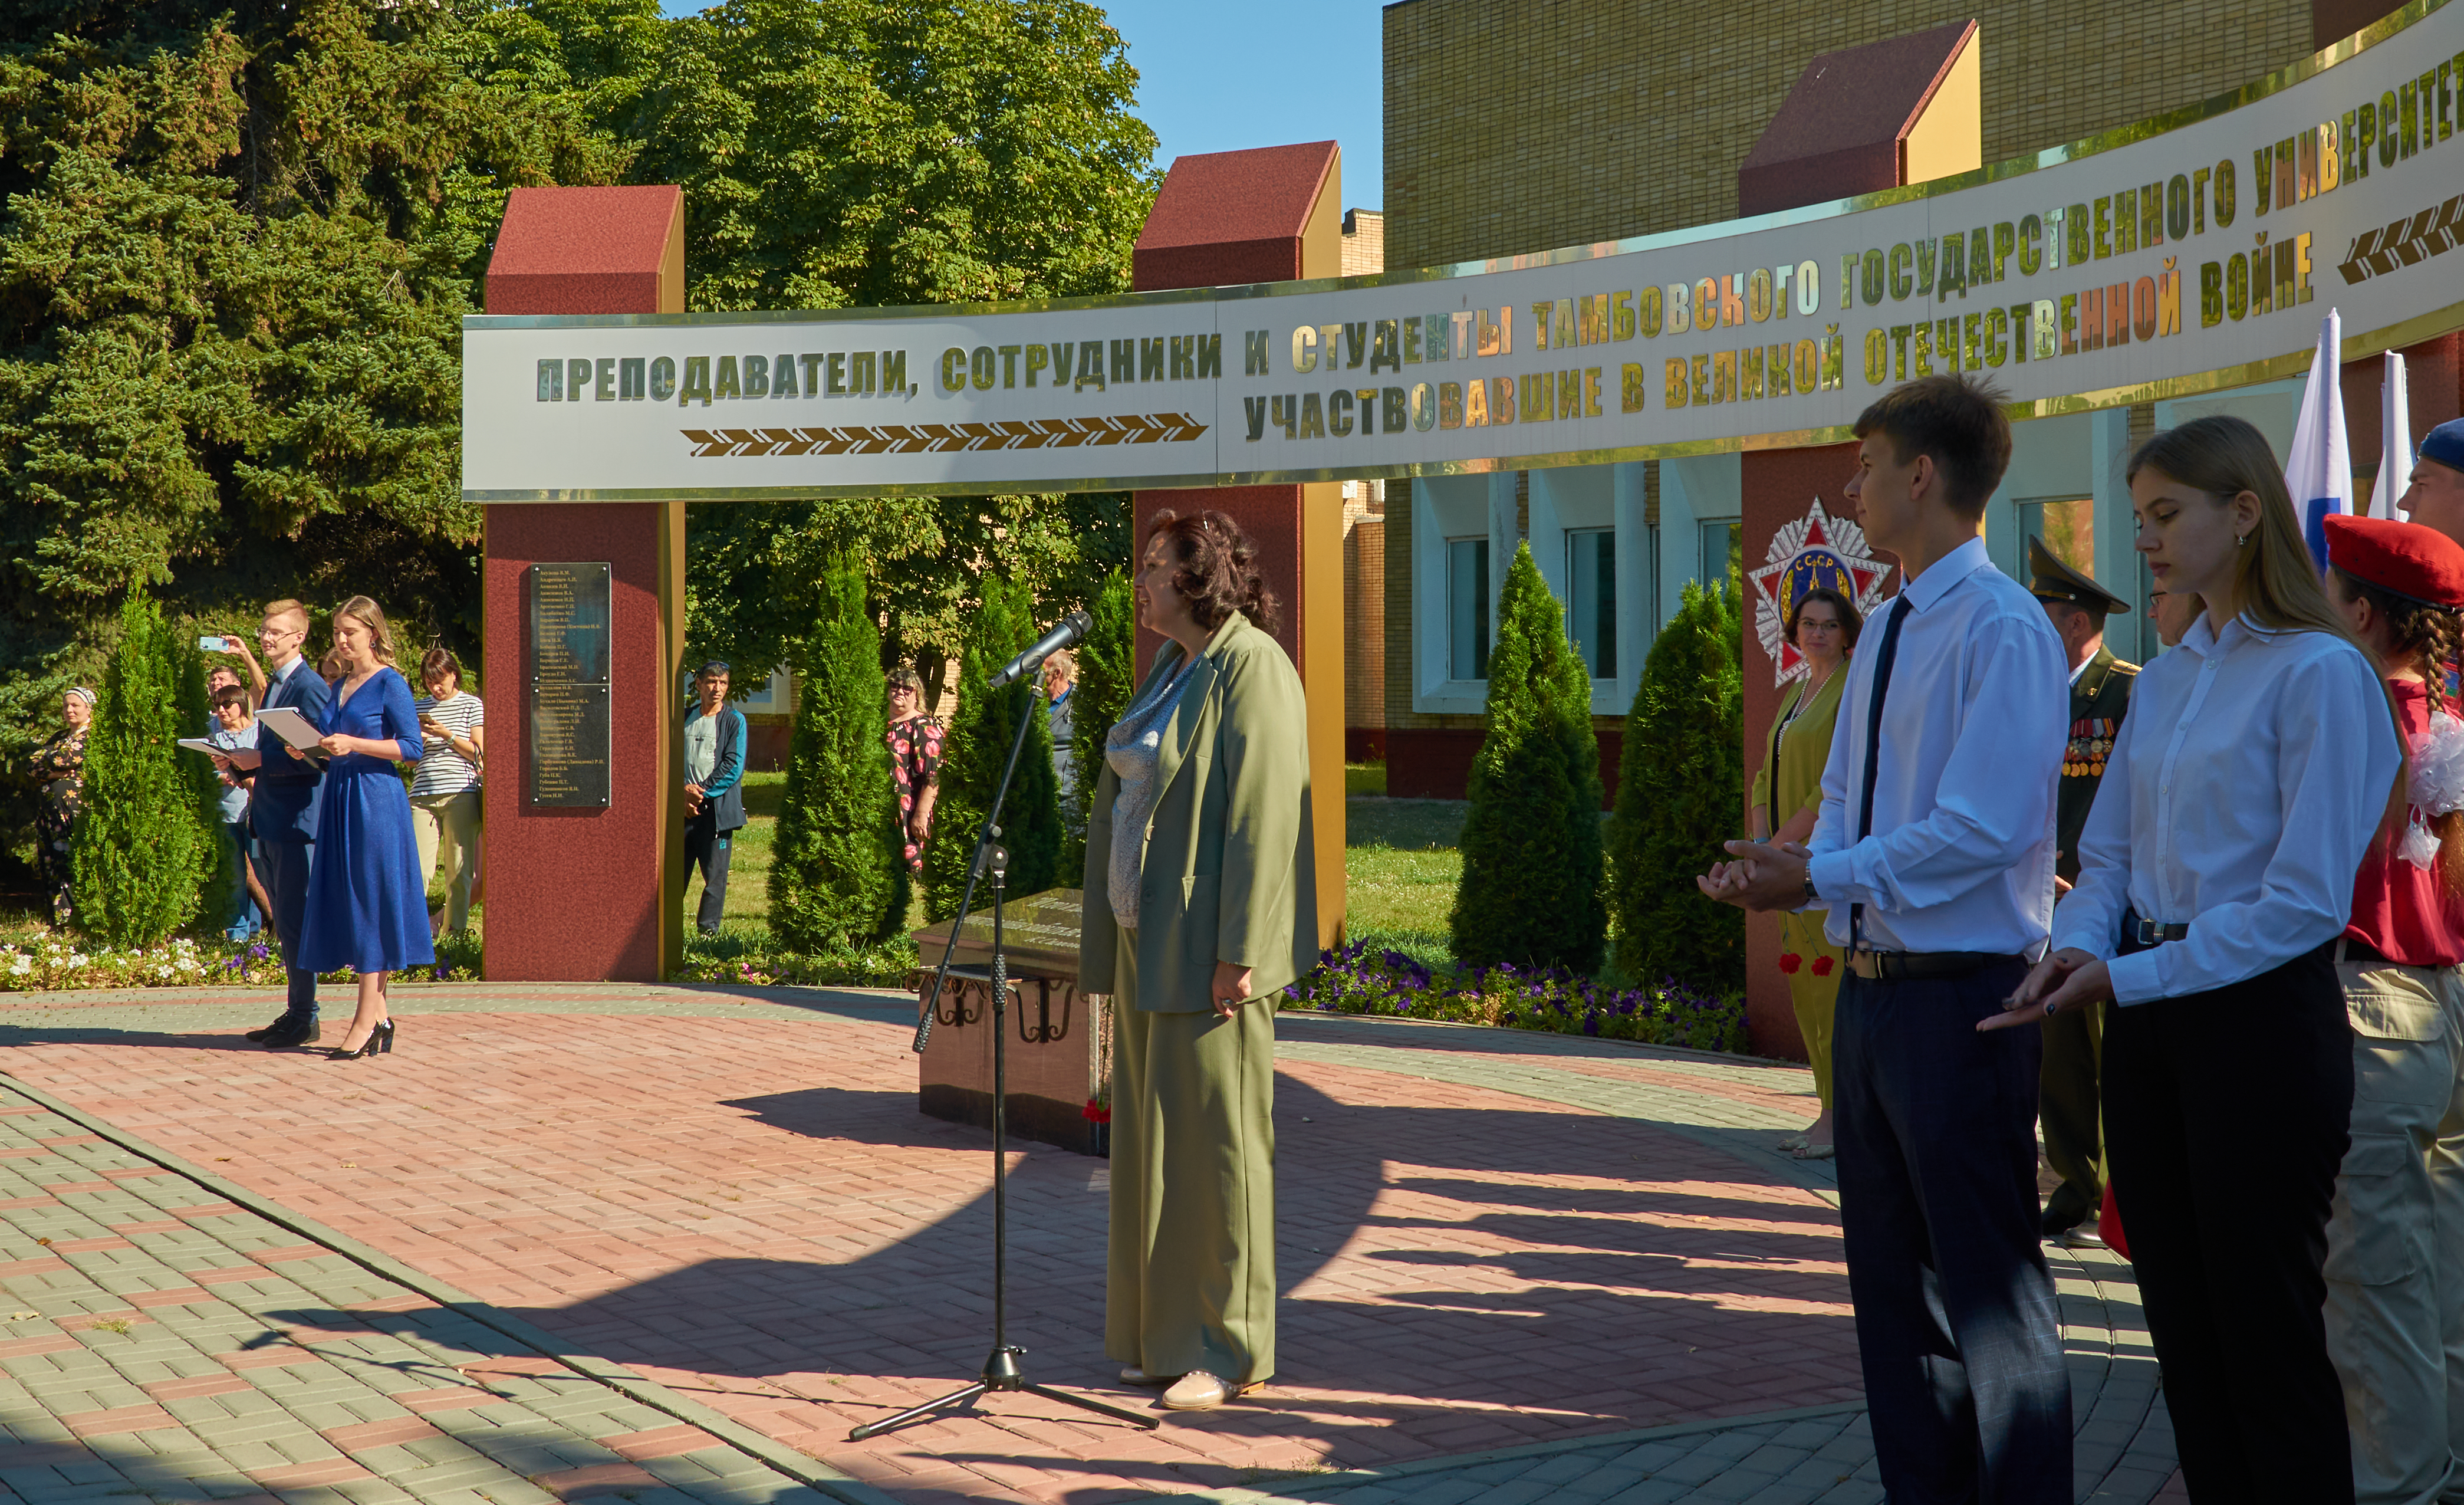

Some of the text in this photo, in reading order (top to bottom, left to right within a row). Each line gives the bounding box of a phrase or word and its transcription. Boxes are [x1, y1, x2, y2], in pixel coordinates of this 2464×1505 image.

[537, 350, 918, 407] ПРЕПОДАВАТЕЛИ,
[942, 334, 1222, 393] СОТРУДНИКИ
[1245, 329, 1269, 376] И
[1291, 305, 1512, 376] СТУДЕНТЫ
[1532, 259, 1820, 350] ТАМБОВСКОГО
[1841, 159, 2236, 309] ГОСУДАРСТВЕННОГО
[1243, 231, 2314, 442] УЧАСТВОВАВШИЕ В ВЕЛИКОЙ ОТЕЧЕСТВЕННОЙ ВОЙНЕ
[1795, 555, 1833, 571] СССР
